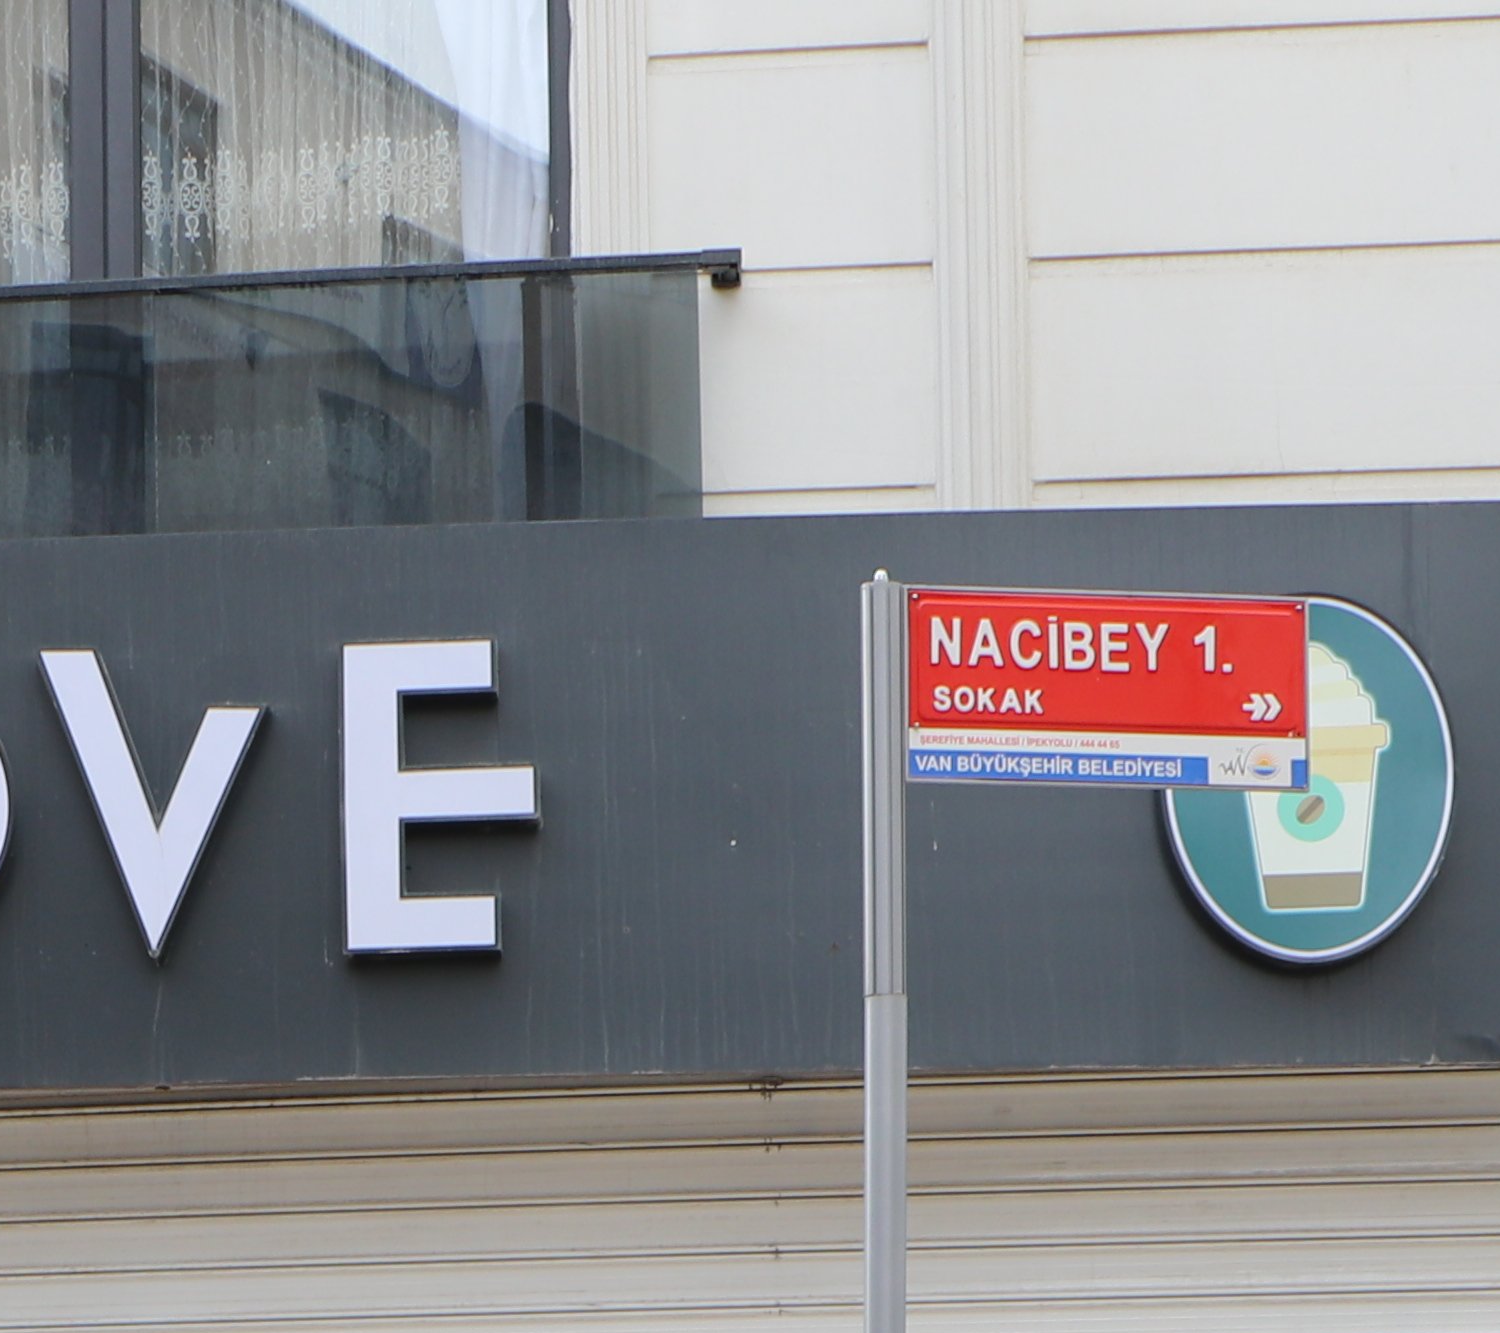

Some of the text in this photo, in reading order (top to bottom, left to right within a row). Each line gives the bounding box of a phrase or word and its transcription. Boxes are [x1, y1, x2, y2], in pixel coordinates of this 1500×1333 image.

[929, 615, 1234, 673] NACİBEY 1.
[933, 685, 1045, 714] SOKAK
[915, 753, 1182, 777] VAN BÜYÜKŞEHİR BELEDİYESİ
